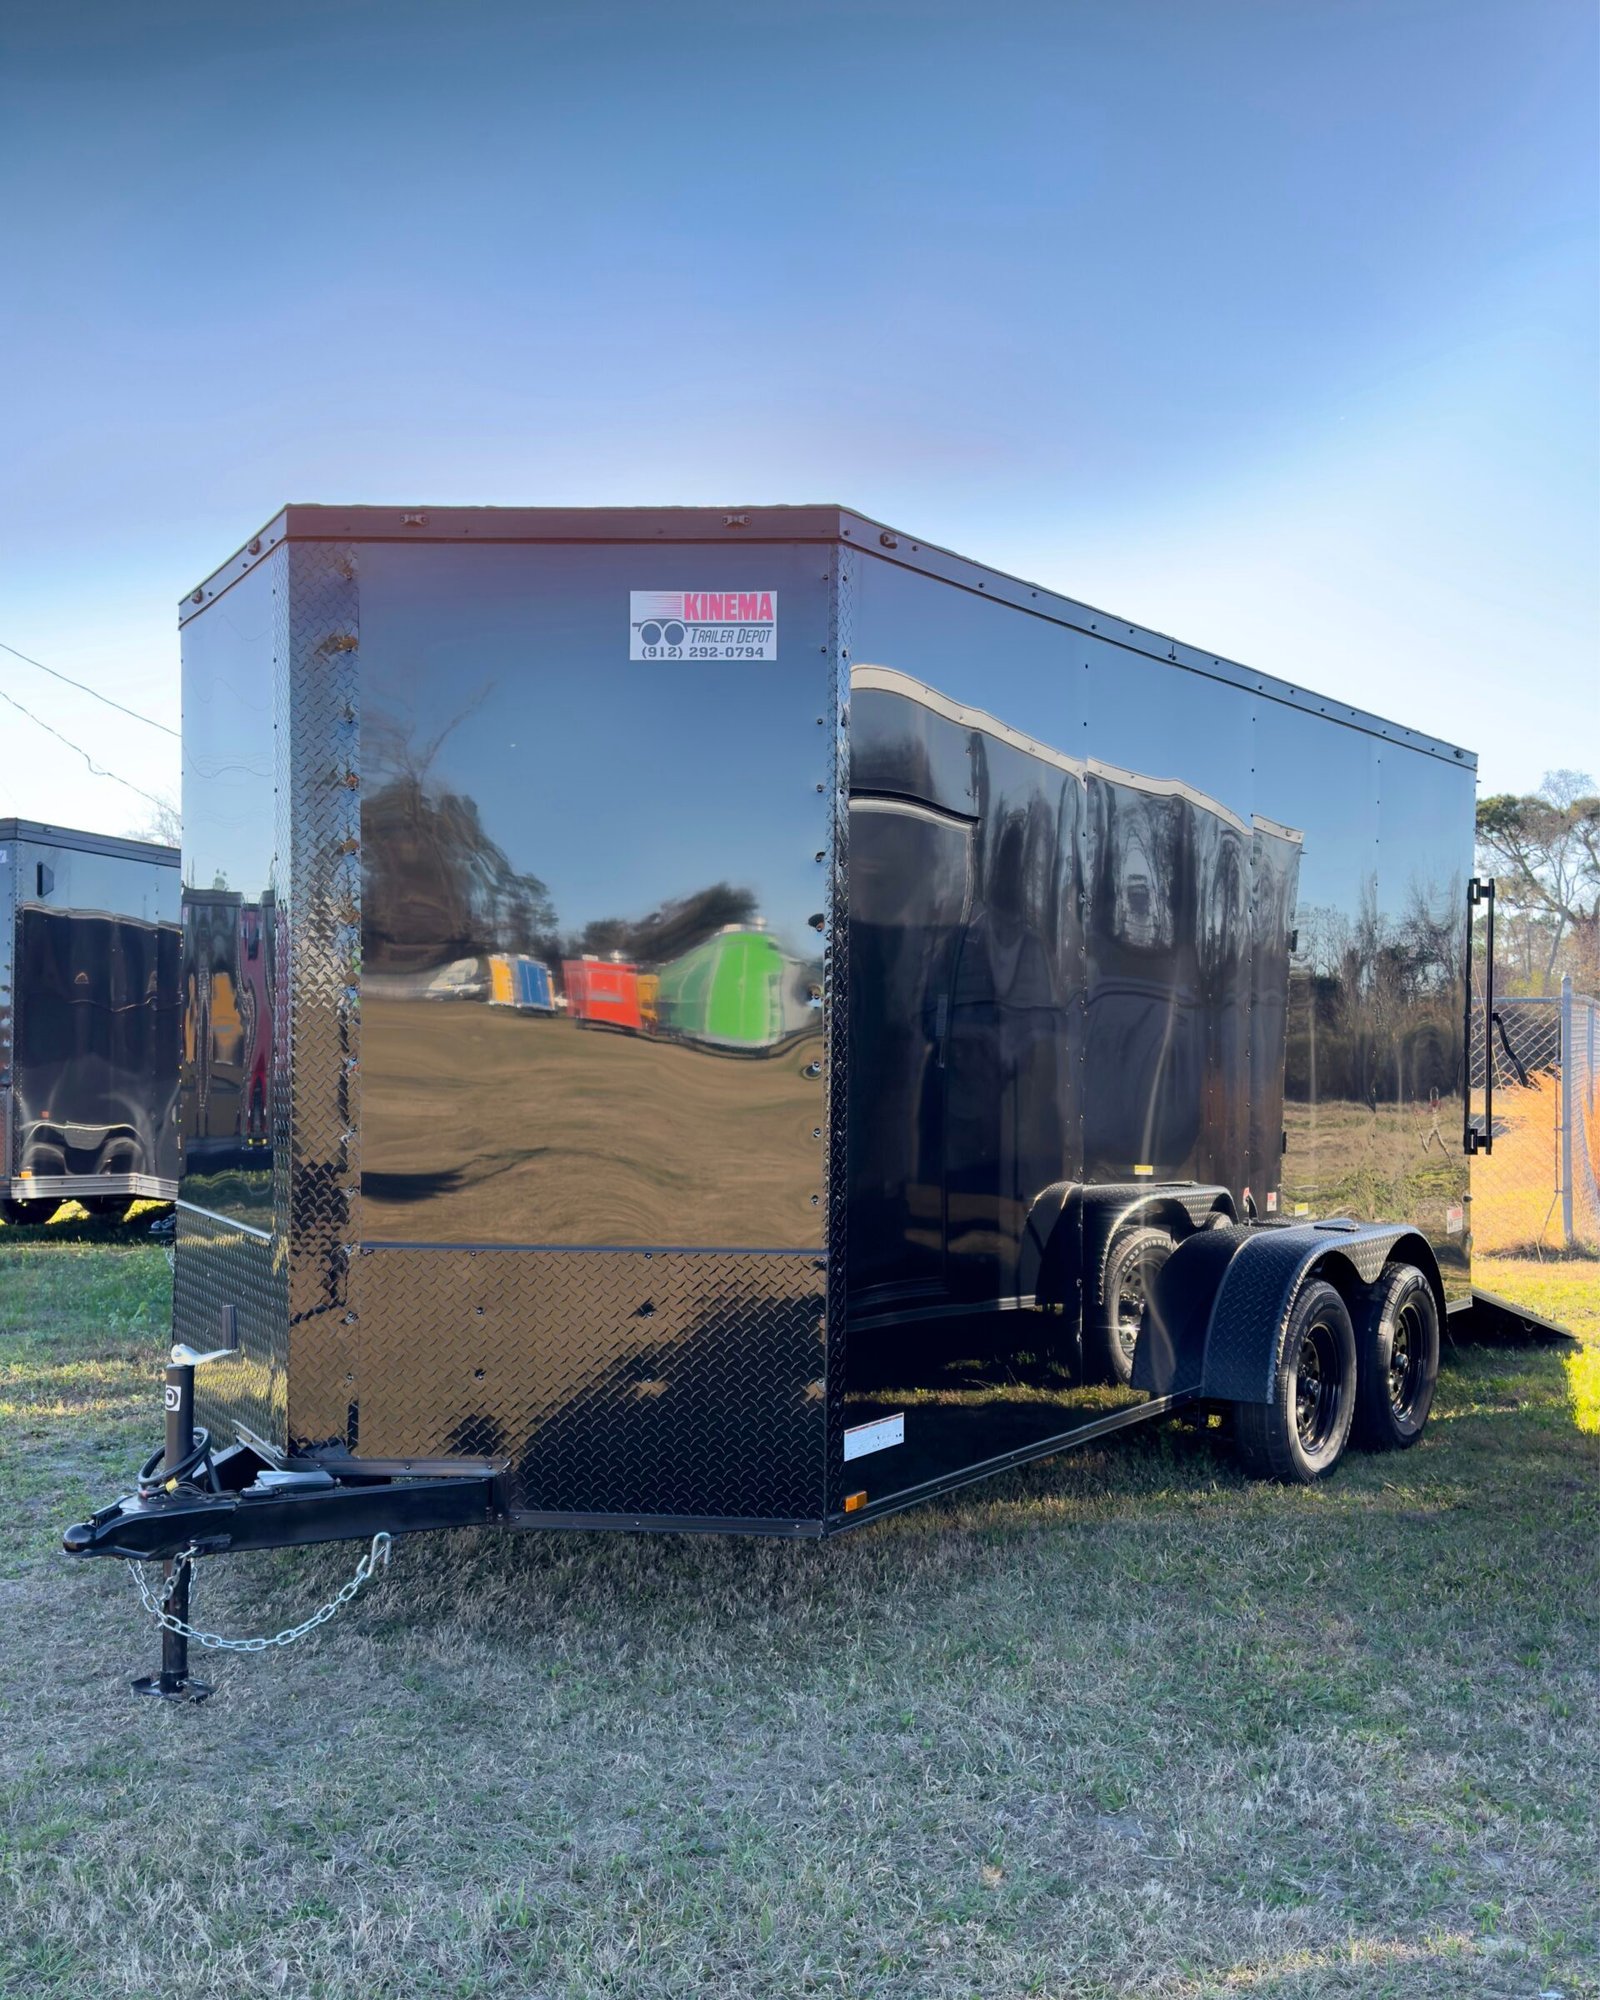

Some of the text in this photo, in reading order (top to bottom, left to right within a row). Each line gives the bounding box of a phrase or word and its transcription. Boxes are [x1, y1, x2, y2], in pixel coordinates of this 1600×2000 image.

[684, 593, 773, 621] KINEMA
[641, 646, 764, 659] (912) 292-0794
